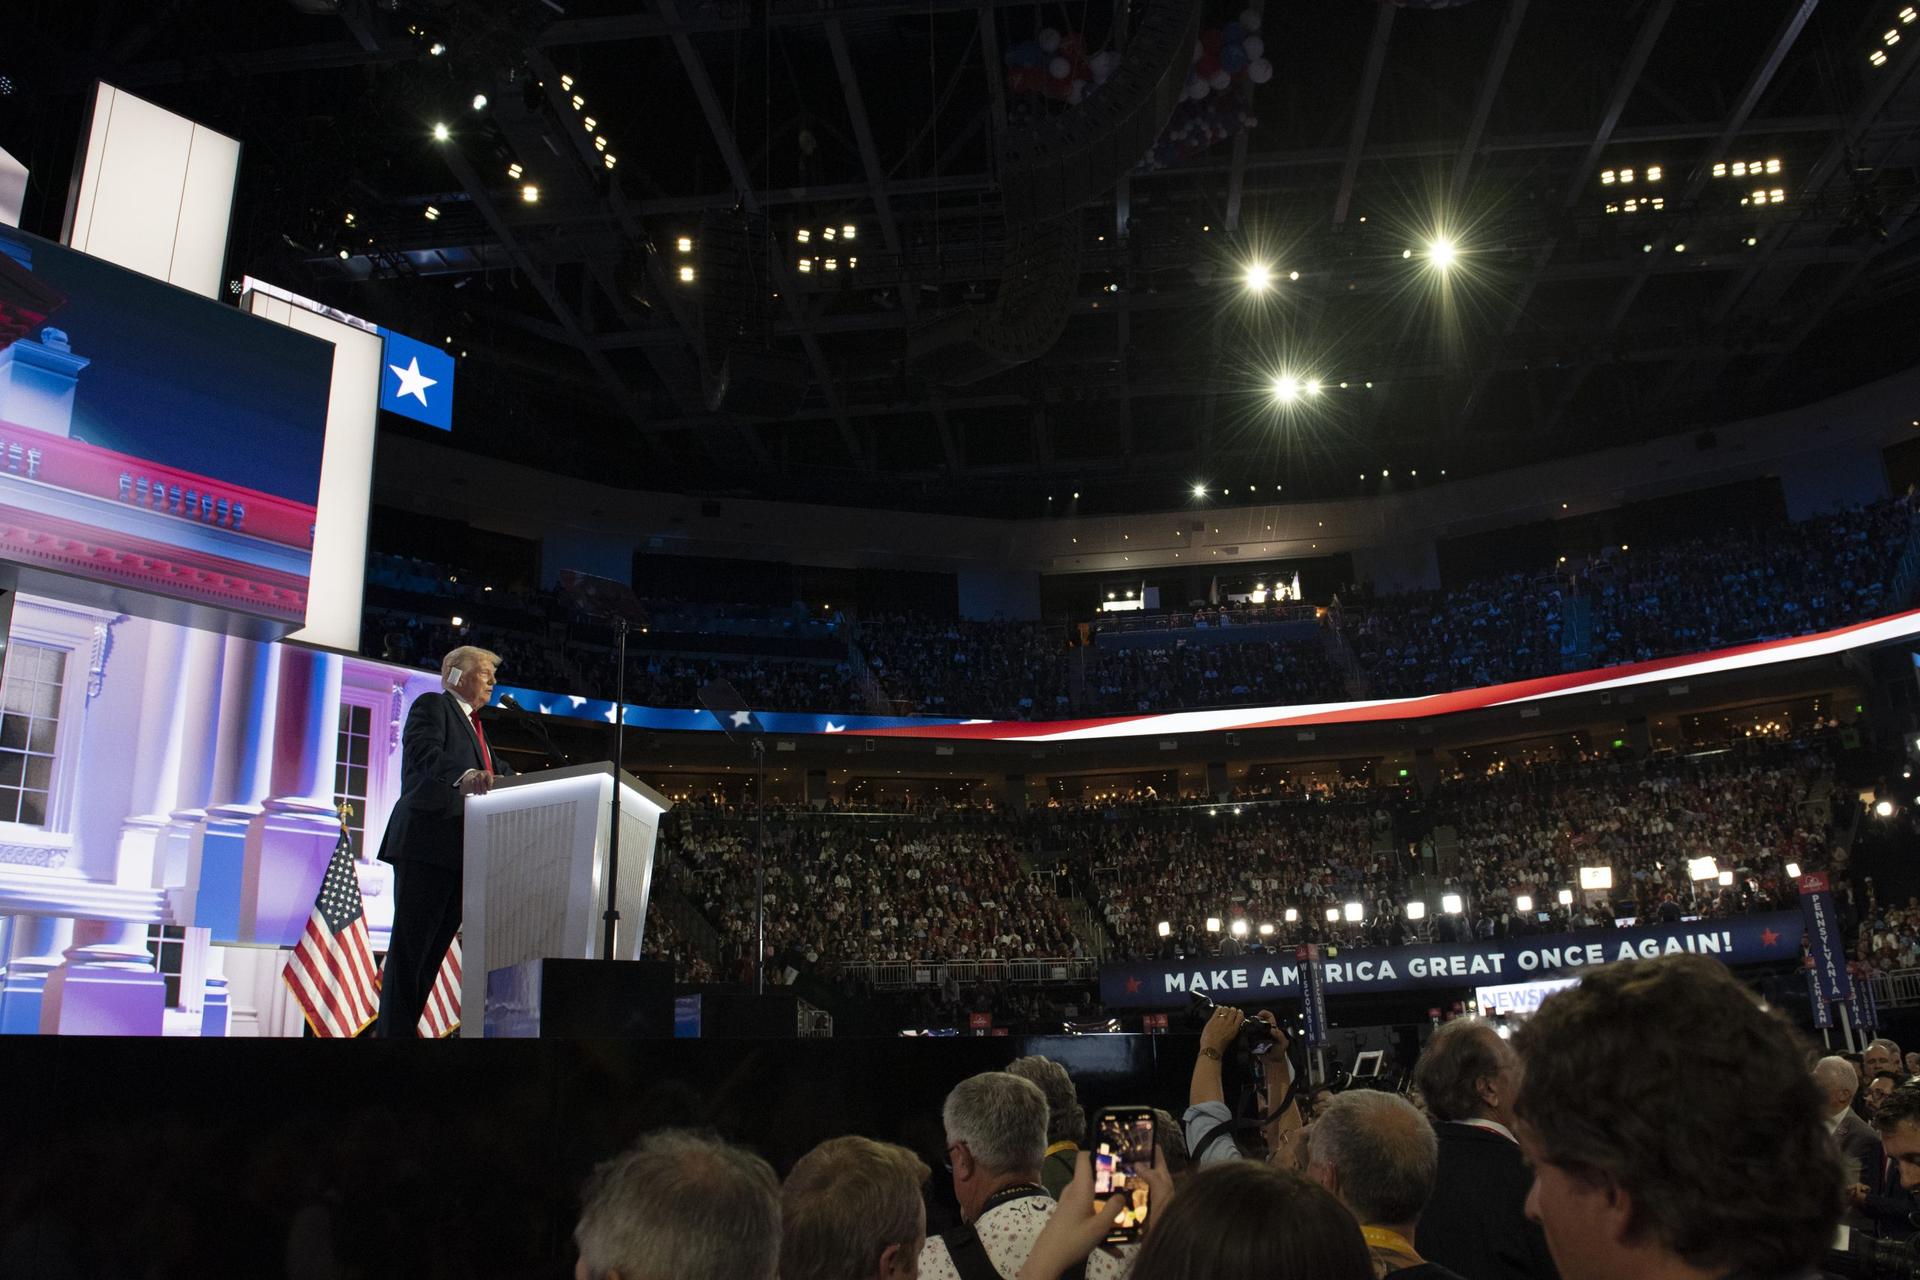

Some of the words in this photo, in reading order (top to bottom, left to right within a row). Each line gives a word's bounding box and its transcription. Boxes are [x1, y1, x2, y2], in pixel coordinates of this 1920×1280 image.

[1164, 968, 1248, 993] MAKE
[1260, 960, 1397, 988] AMRICA
[1408, 953, 1505, 978] GREAT
[1517, 943, 1605, 971] ONCE
[1617, 931, 1732, 961] AGAIN!
[1811, 894, 1841, 995] PENNSYLVANIA
[1300, 963, 1315, 1041] WISCONSIN
[1312, 962, 1326, 1041] WISCONSIN
[1811, 968, 1827, 1024] MICHIGAN
